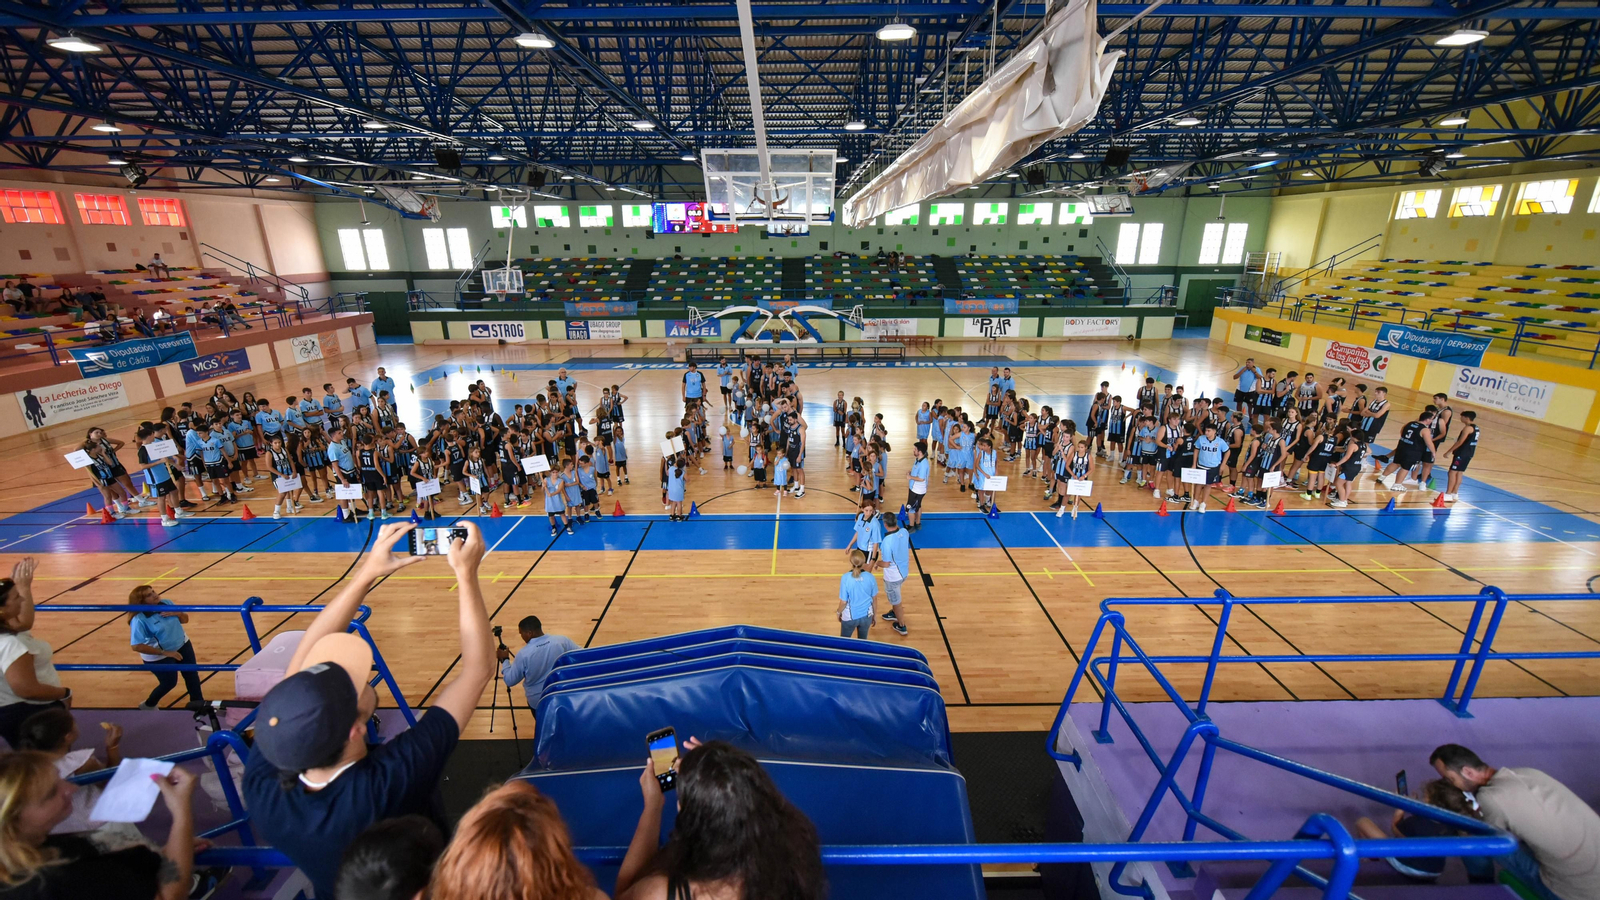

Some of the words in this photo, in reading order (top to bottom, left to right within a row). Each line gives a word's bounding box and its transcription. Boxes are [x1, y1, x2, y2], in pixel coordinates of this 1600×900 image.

[491, 323, 524, 337] STROG
[568, 330, 588, 340] UBAGO
[980, 318, 1011, 339] PILAR
[109, 344, 154, 358] Diputación
[158, 337, 192, 350] DEPORTES
[1404, 331, 1442, 345] Diputación
[1447, 339, 1485, 351] DEPORTES
[1401, 343, 1410, 351] de
[1411, 344, 1432, 355] Cádiz
[116, 359, 127, 368] de
[128, 355, 151, 366] Cádiz
[192, 358, 219, 373] MGS
[1459, 368, 1547, 400] Sumitecni
[39, 396, 50, 404] La
[88, 385, 98, 394] de
[99, 380, 122, 392] Diego
[1405, 429, 1414, 439] 3
[1202, 445, 1217, 453] ULB
[362, 457, 371, 465] 11
